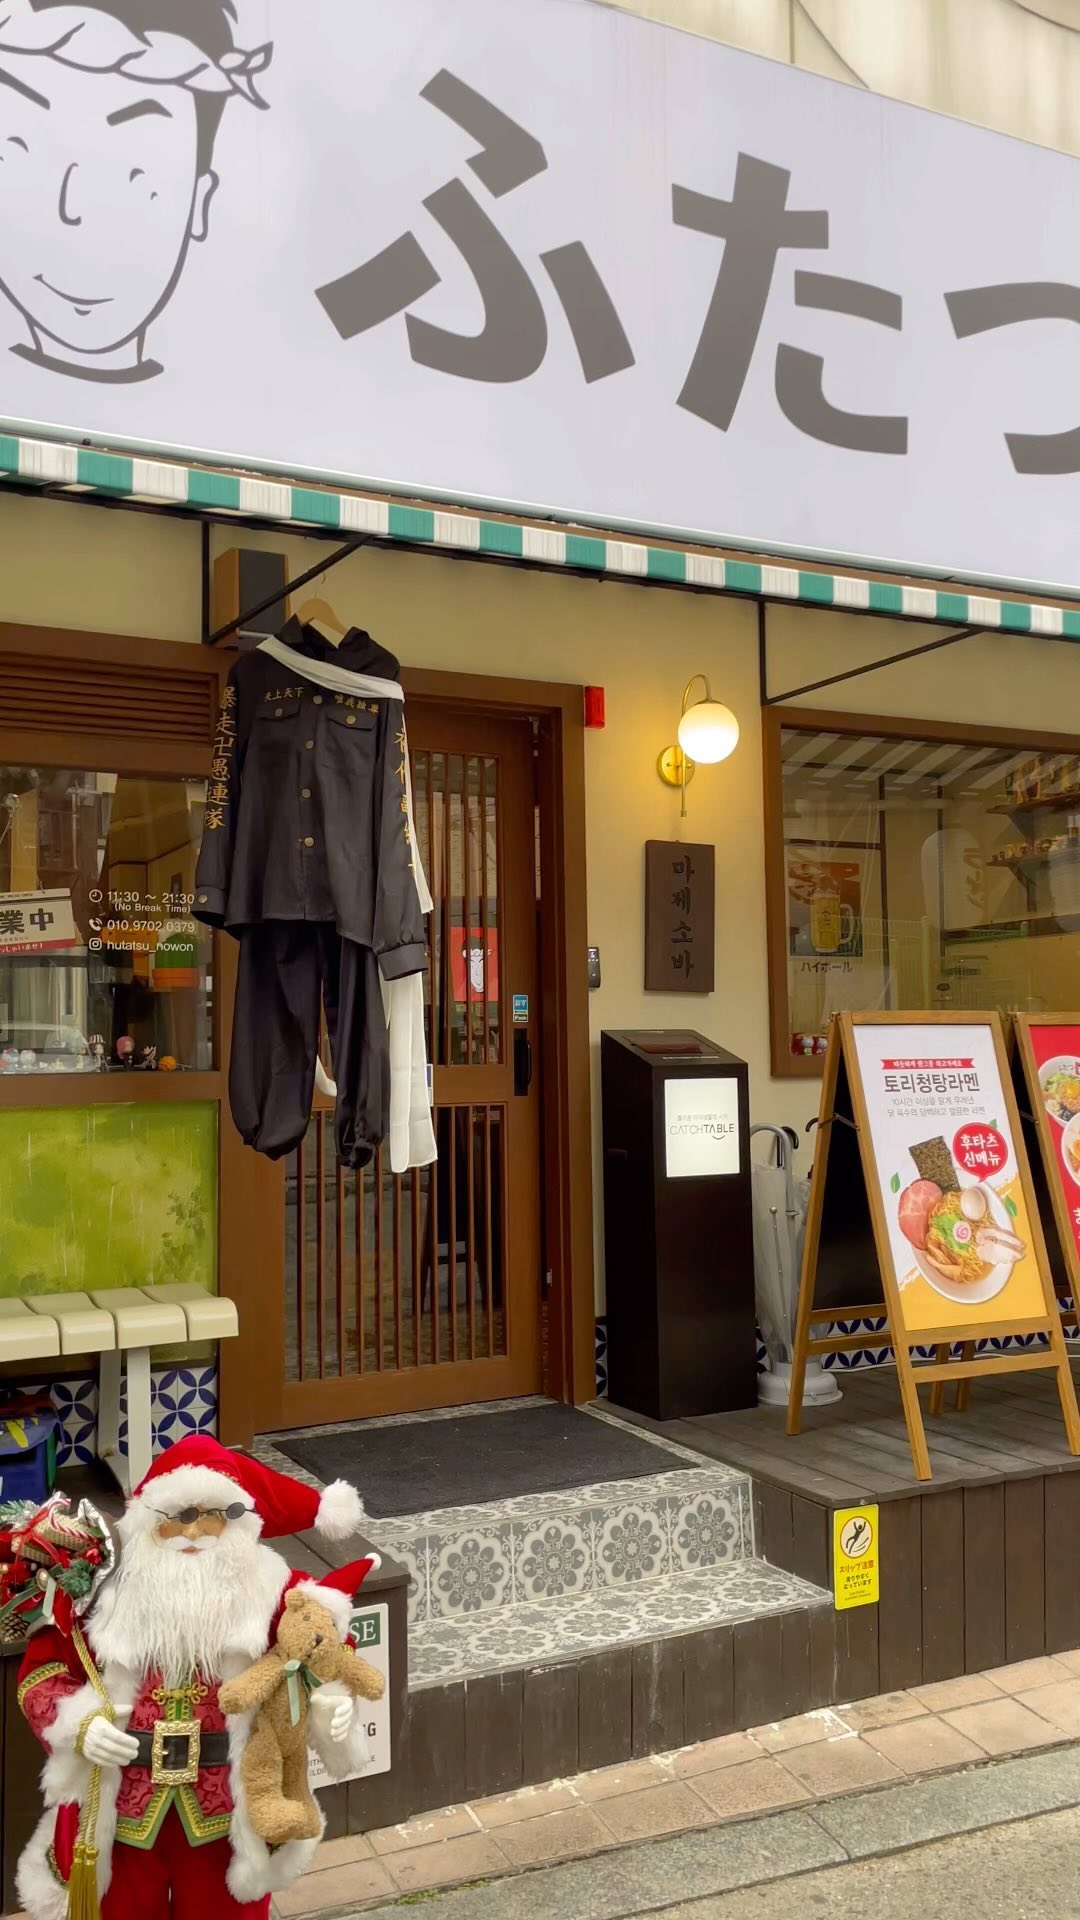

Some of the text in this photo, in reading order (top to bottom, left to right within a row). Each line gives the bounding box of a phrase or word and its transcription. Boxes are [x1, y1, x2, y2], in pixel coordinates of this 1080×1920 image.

[107, 891, 139, 902] 11:30
[162, 892, 194, 904] 21:30
[114, 902, 191, 914] (No Break Time)
[671, 855, 695, 979] 마제소바
[107, 920, 195, 933] 010.9702.0379
[107, 939, 194, 953] hutatsu_nowon
[801, 961, 853, 974] ハイホール
[884, 1073, 981, 1093] 토리청탕라멘
[960, 1133, 999, 1150] 후타츠
[963, 1151, 1001, 1168] 신메뉴
